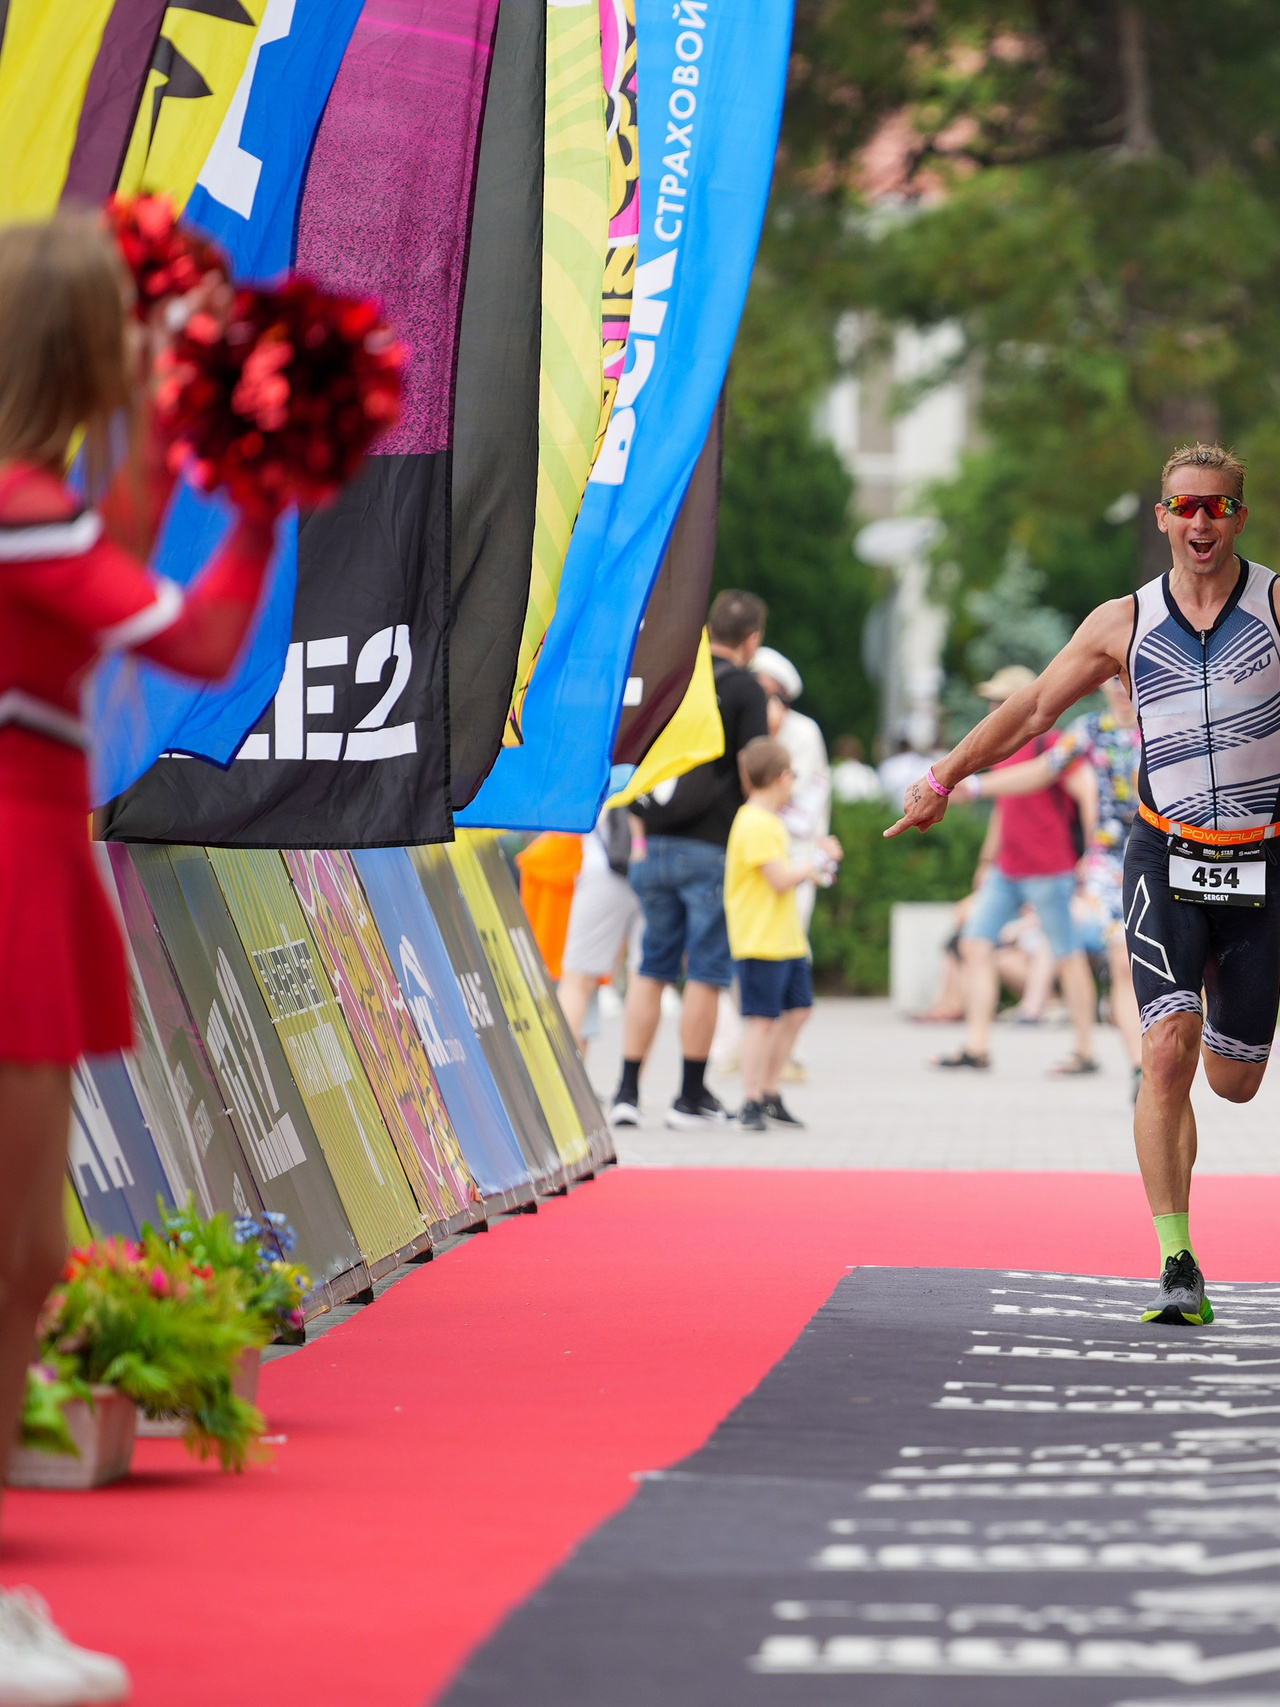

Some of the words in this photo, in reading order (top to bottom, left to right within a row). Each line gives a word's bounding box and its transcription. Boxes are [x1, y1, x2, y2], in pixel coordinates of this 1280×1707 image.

[653, 0, 708, 242] СТРАХОВОЙ
[1233, 653, 1271, 685] 2XU
[1181, 826, 1264, 843] POWERUP
[1191, 866, 1240, 889] 454
[1203, 893, 1229, 902] SERGEY
